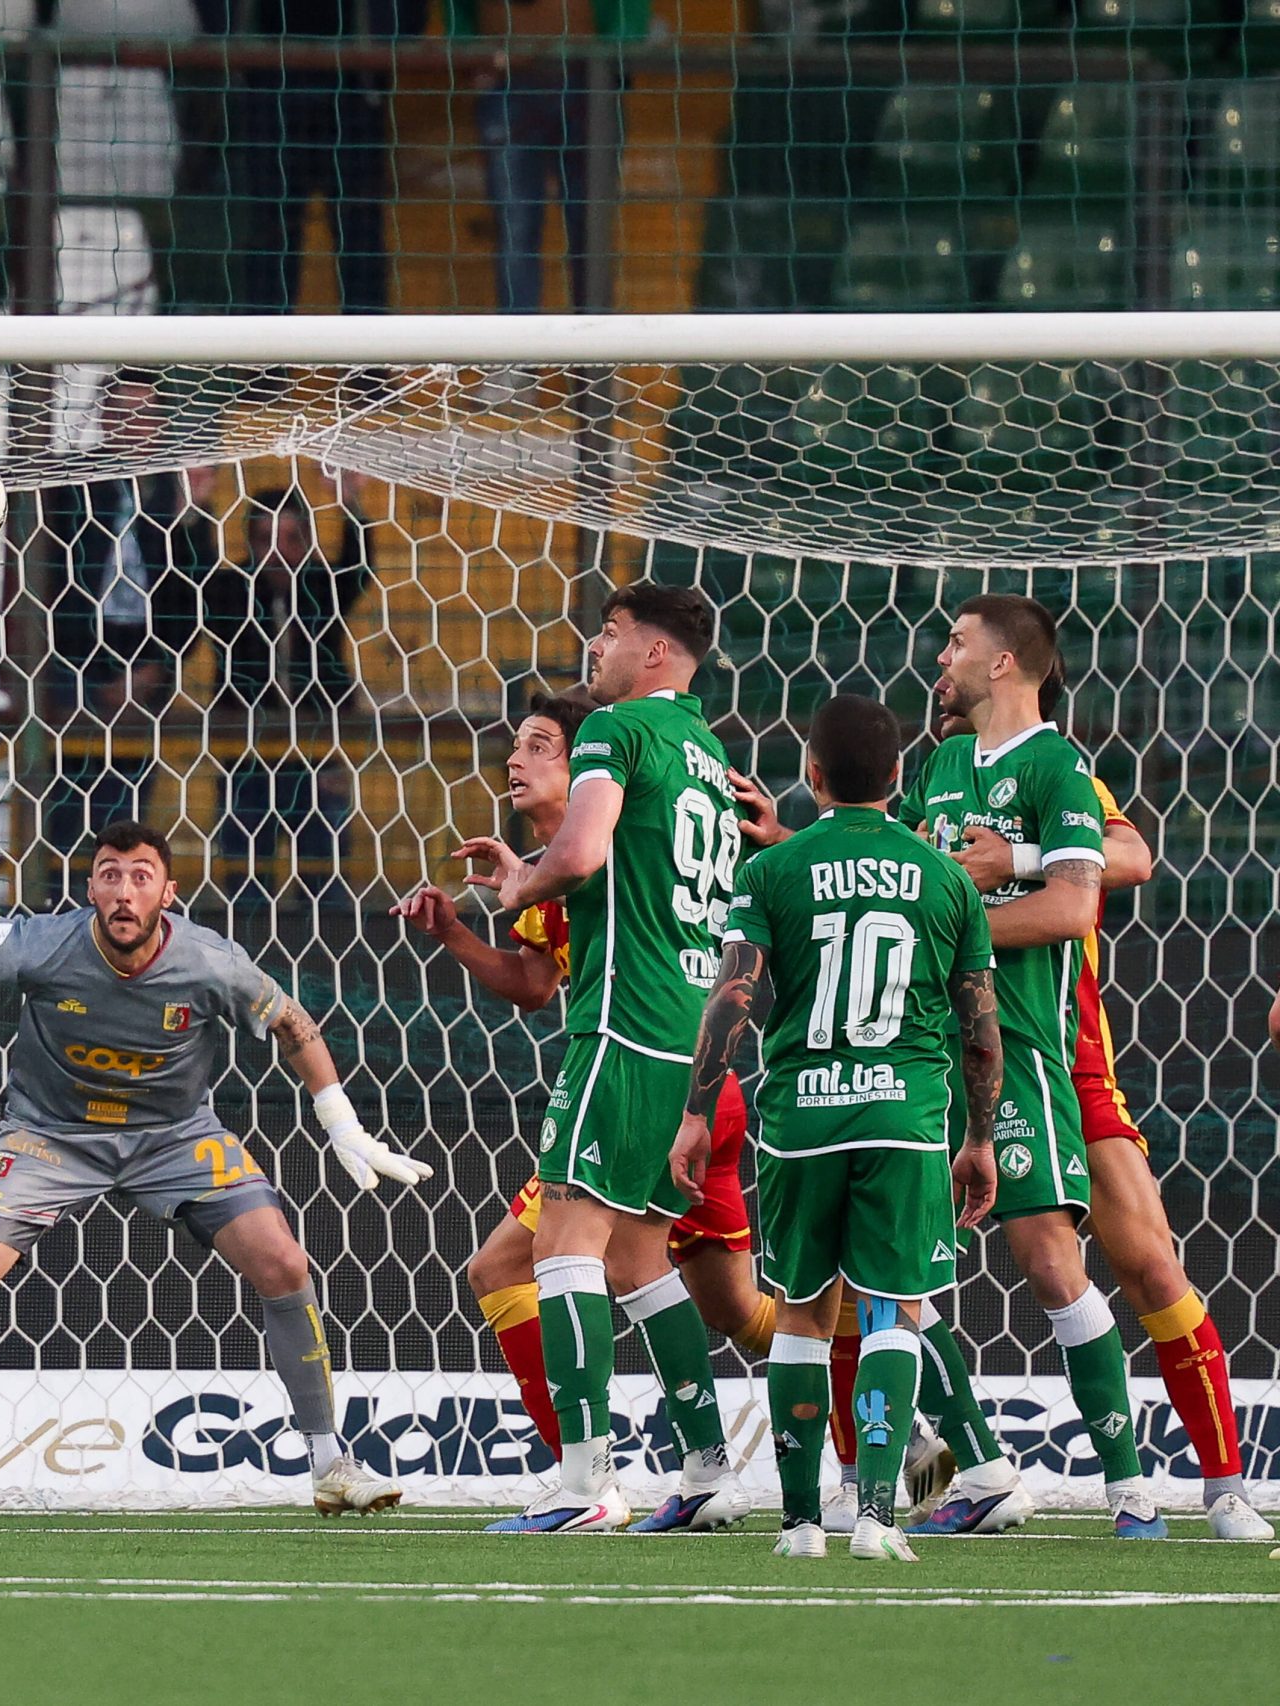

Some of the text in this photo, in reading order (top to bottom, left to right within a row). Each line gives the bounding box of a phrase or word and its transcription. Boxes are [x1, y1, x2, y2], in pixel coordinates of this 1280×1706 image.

[811, 858, 921, 902] RUSSO
[807, 911, 920, 1049] 10
[65, 1044, 165, 1078] coop
[799, 1091, 904, 1106] PORTE & FINESTRE
[994, 1118, 1027, 1132] GRUPPO
